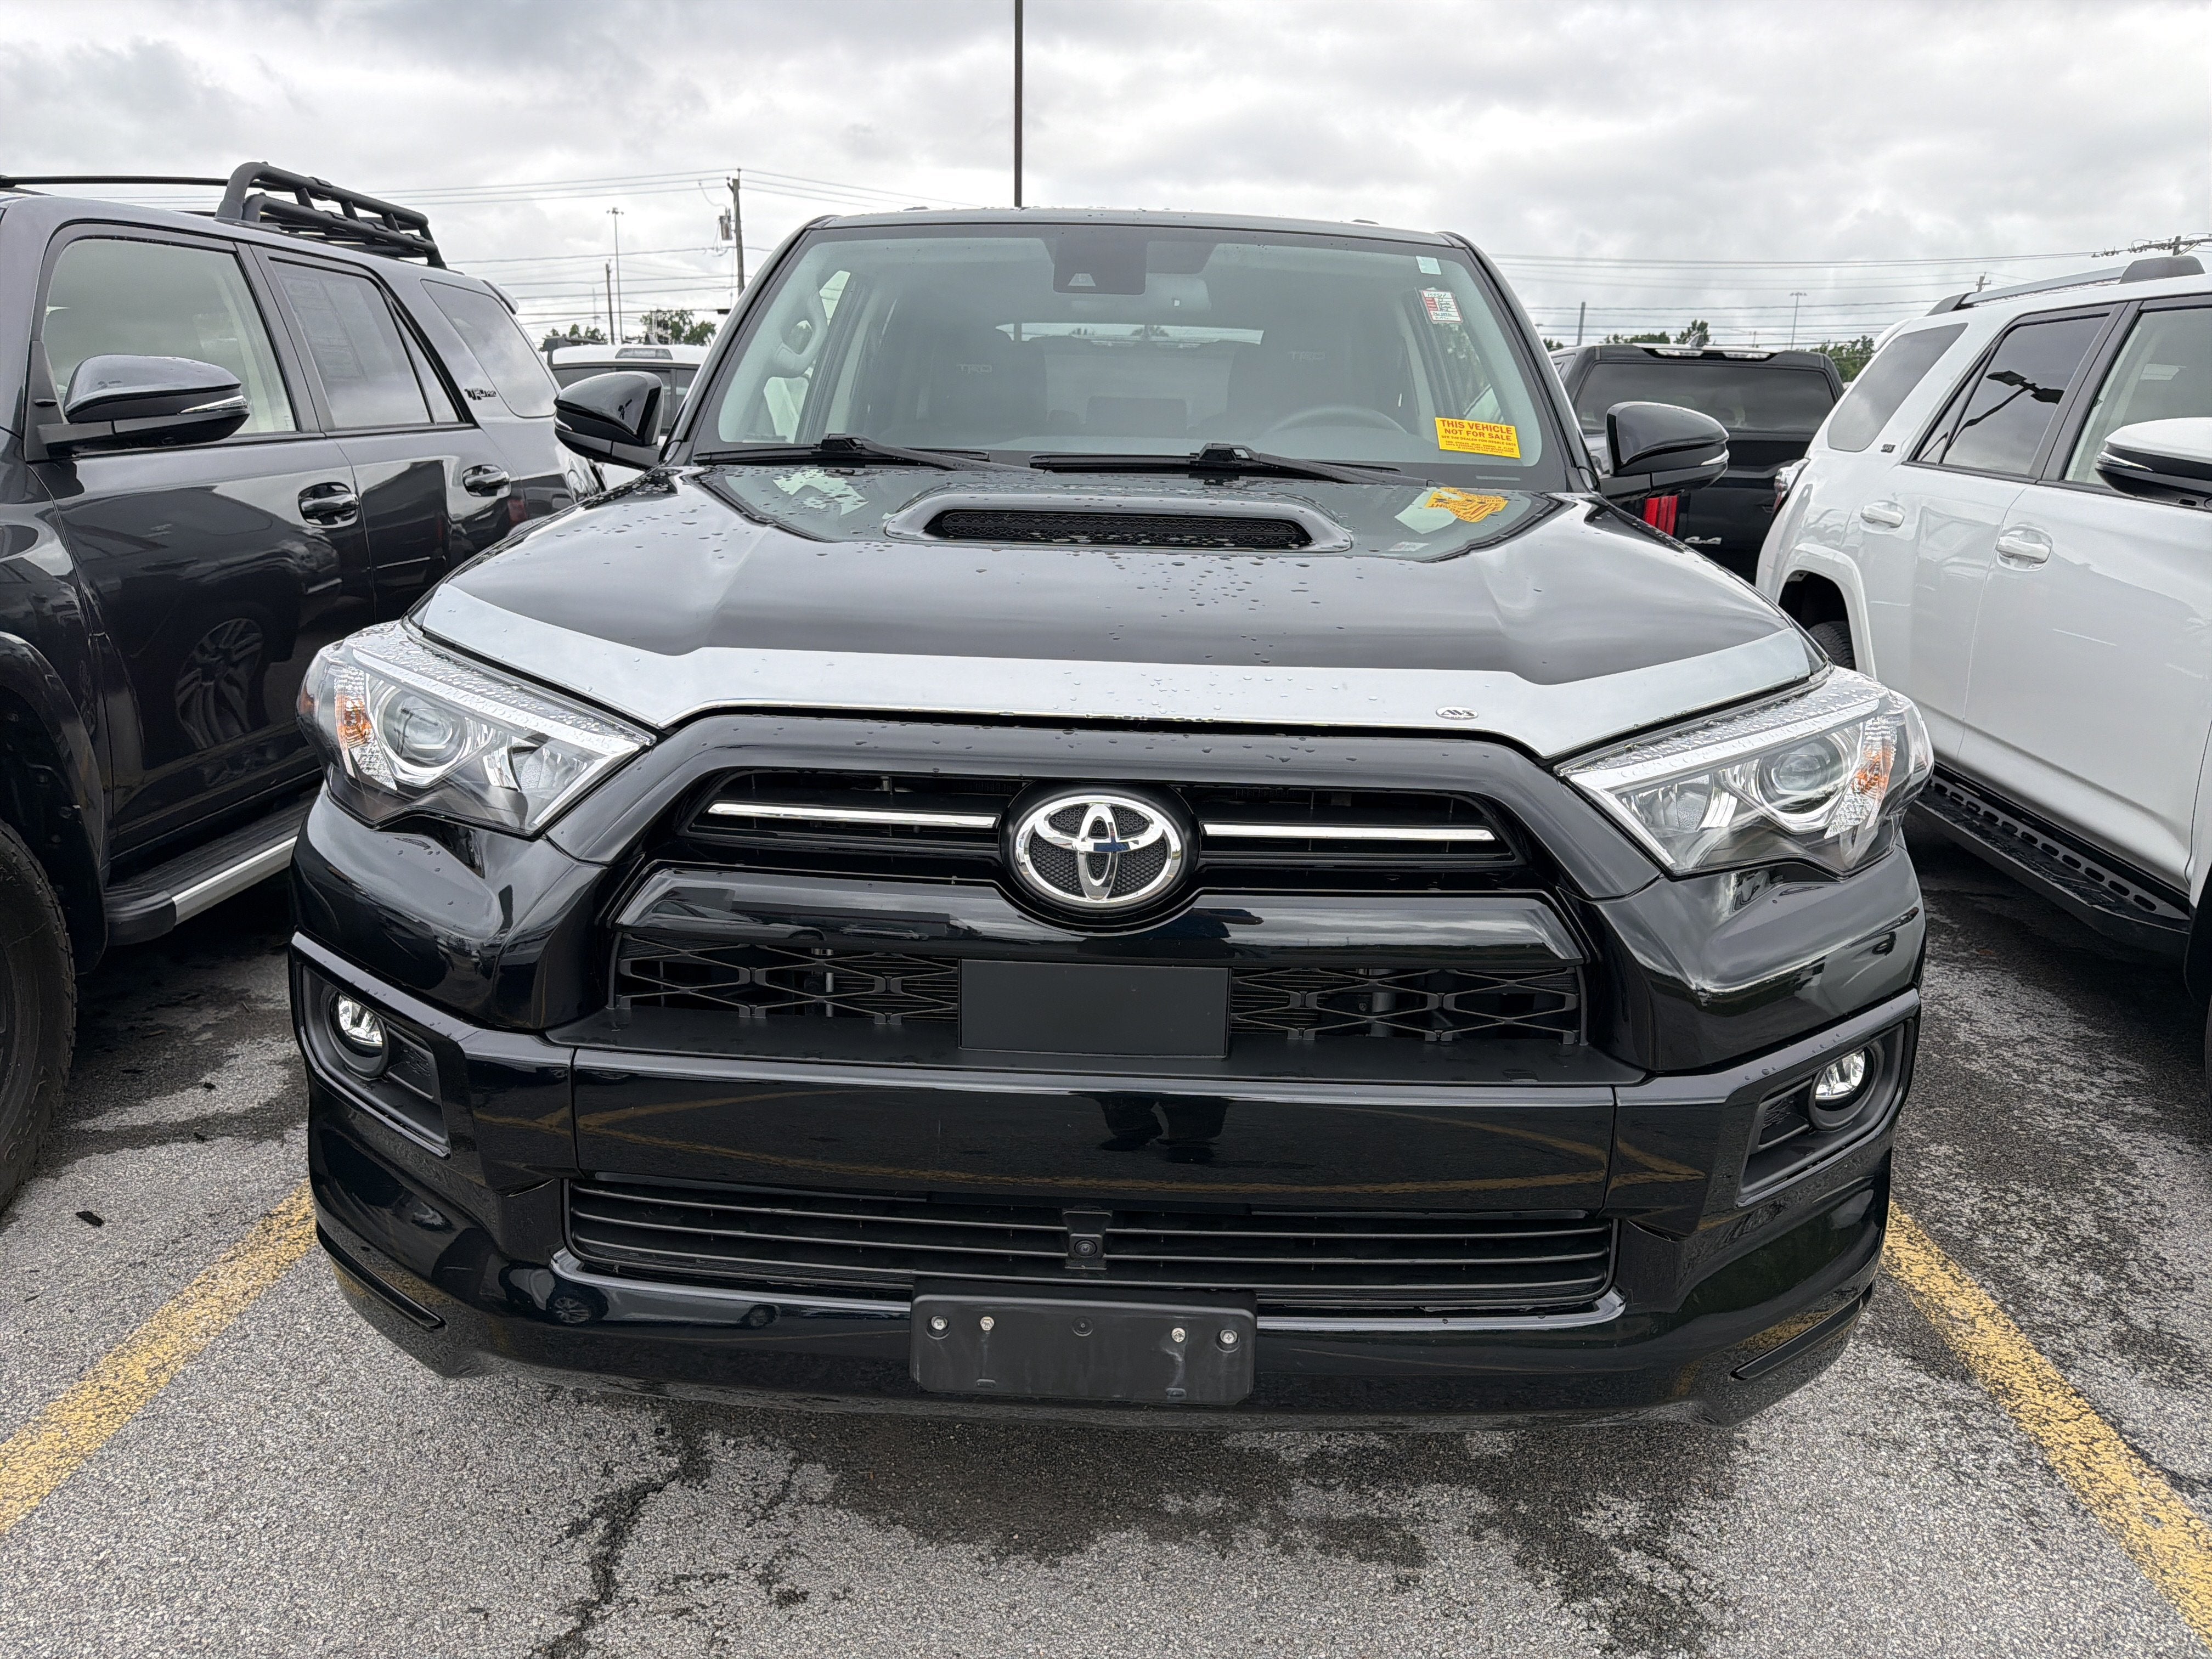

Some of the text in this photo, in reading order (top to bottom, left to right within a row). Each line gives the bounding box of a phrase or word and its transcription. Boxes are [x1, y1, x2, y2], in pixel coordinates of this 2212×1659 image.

[1440, 420, 1513, 435] THIS VEHICLE
[1488, 433, 1512, 441] SALE
